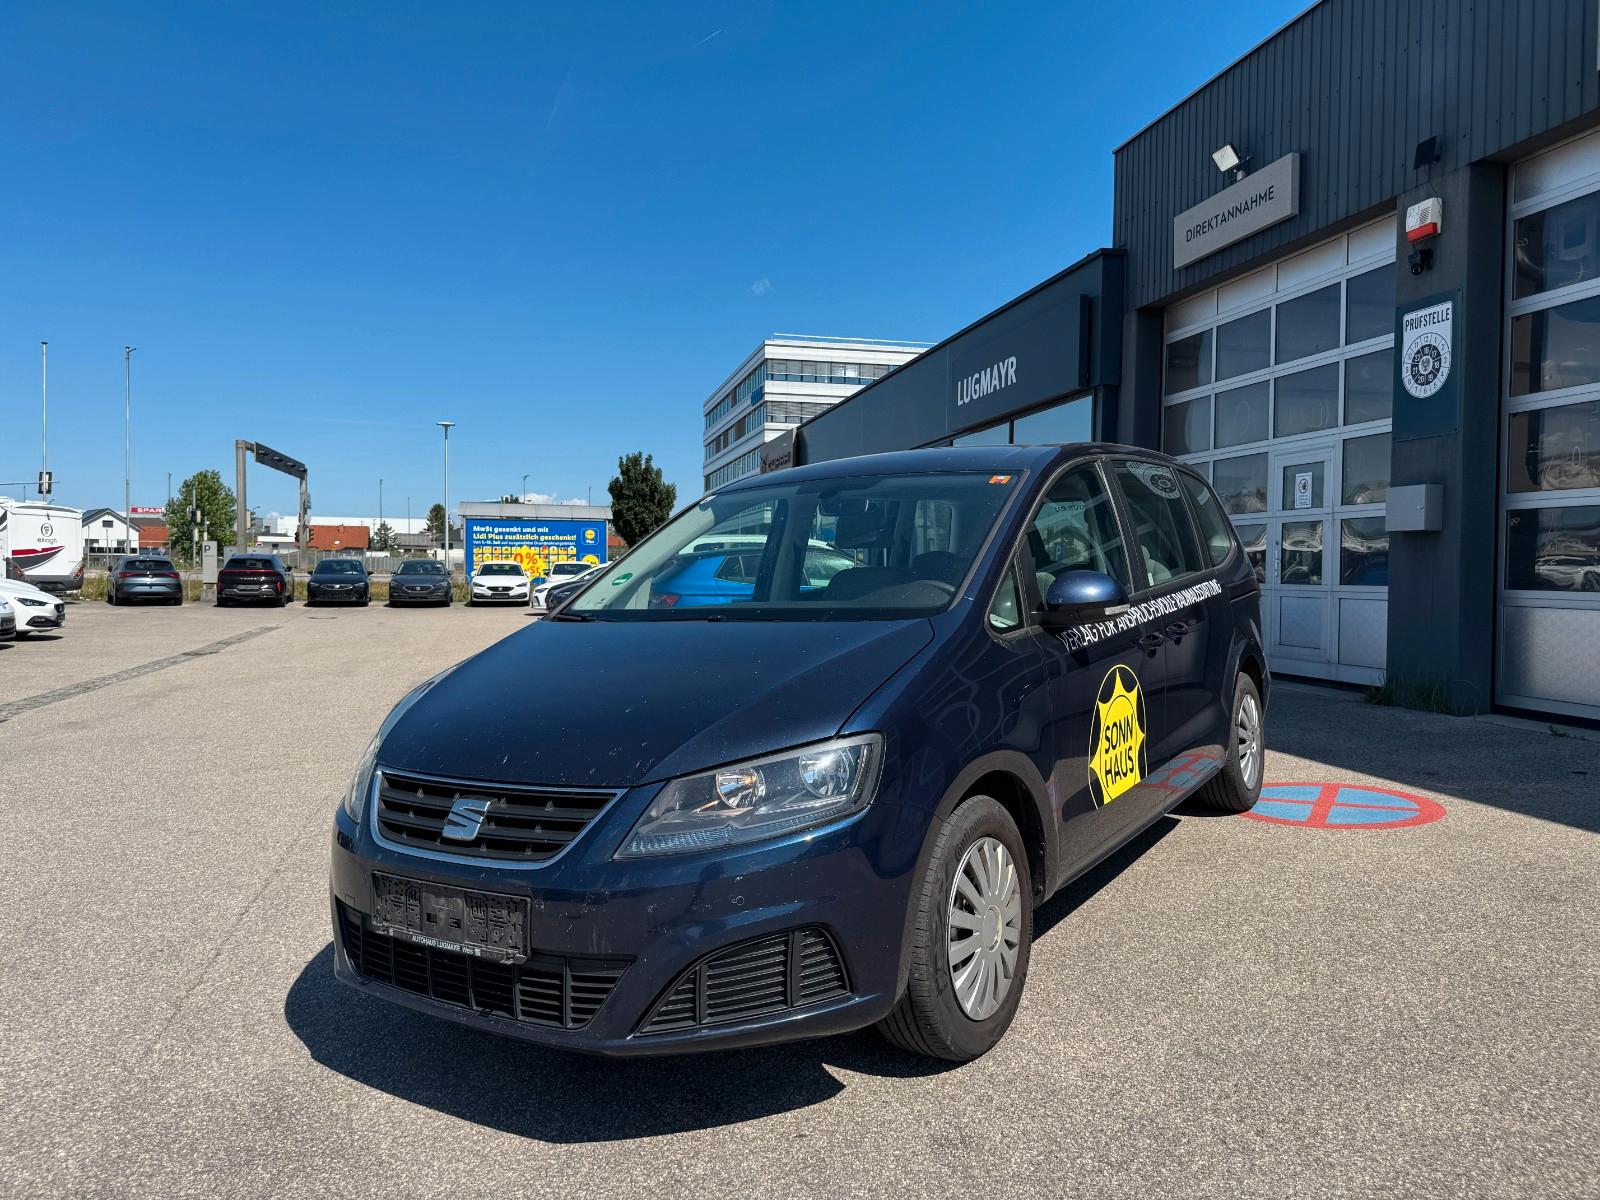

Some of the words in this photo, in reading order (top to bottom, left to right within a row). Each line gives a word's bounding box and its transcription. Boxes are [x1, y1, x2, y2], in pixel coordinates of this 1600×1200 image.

[1186, 184, 1275, 243] DIREKTANNAHME
[1405, 307, 1450, 333] PRÜFSTELLE
[957, 355, 1017, 407] LUGMAYR
[493, 526, 522, 534] gesenkt
[204, 545, 211, 553] P
[1055, 623, 1099, 653] VERLAG
[1104, 712, 1134, 755] SONN
[1104, 745, 1135, 788] HAUS
[411, 935, 437, 947] AUTOHAUS
